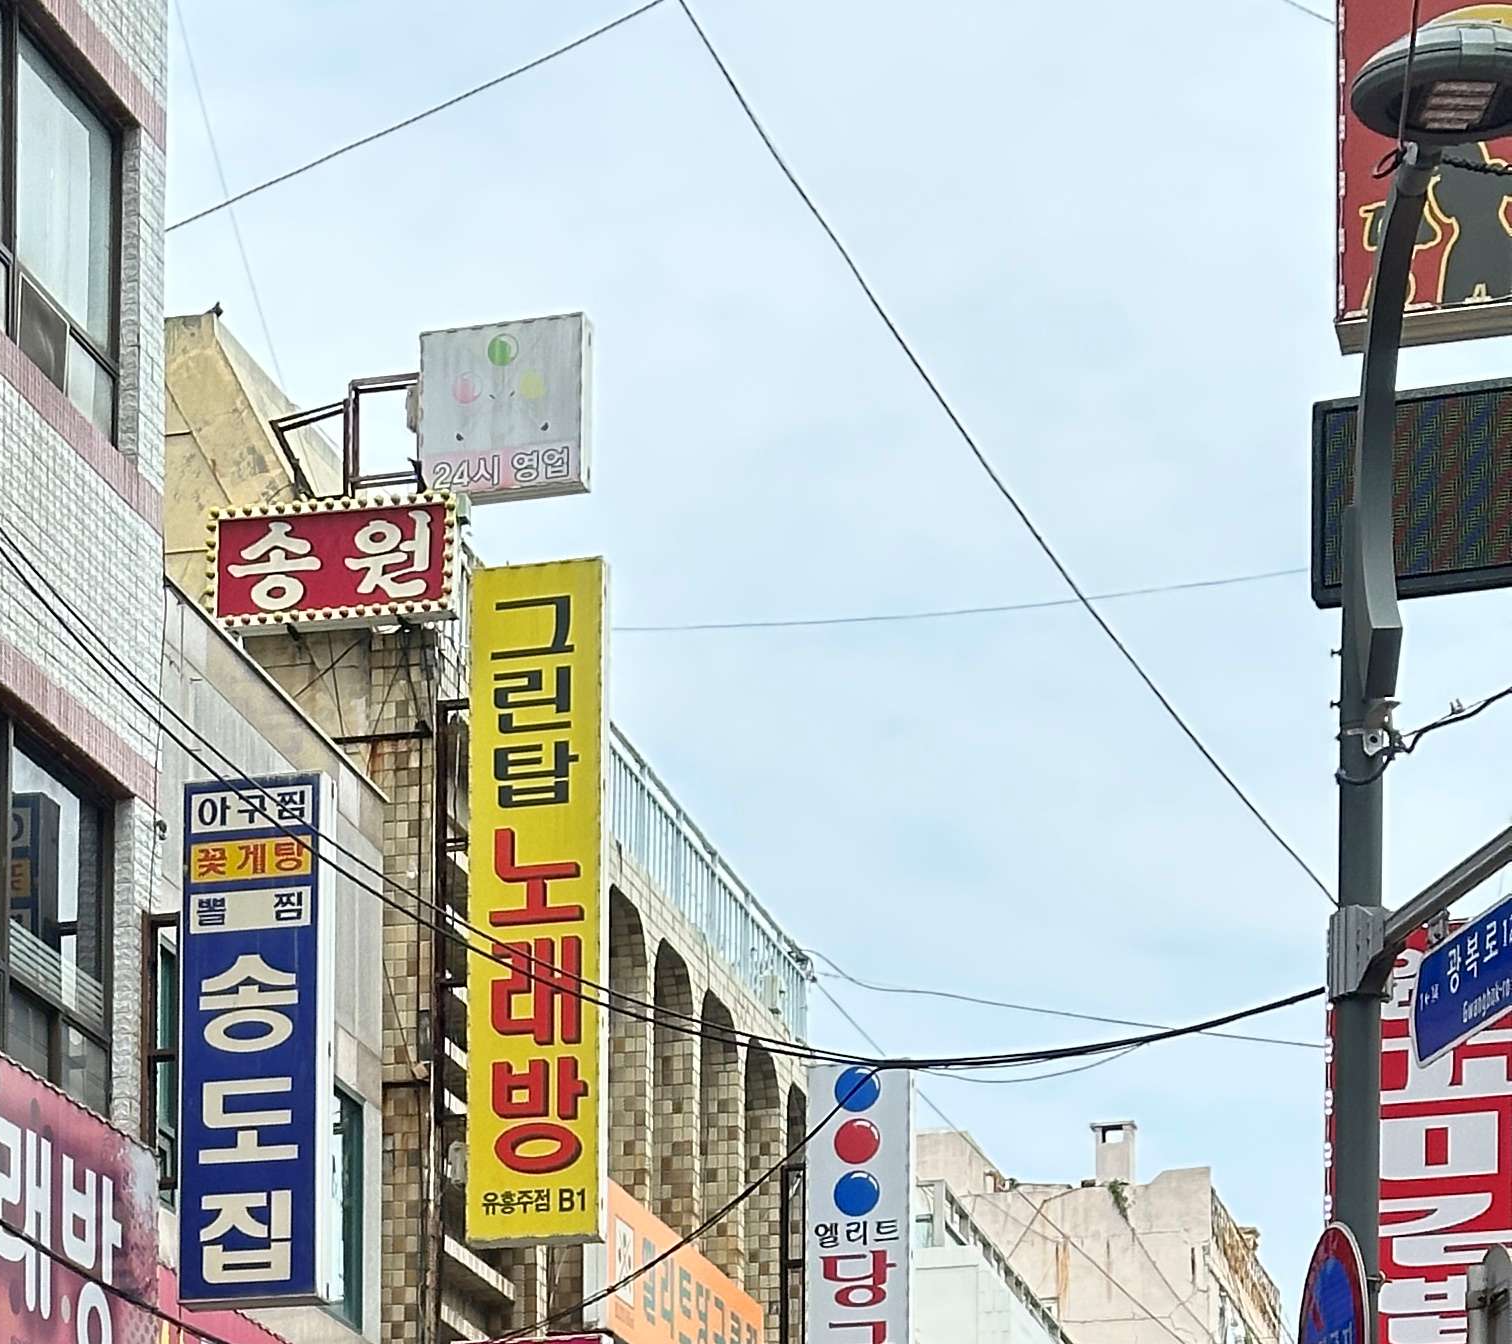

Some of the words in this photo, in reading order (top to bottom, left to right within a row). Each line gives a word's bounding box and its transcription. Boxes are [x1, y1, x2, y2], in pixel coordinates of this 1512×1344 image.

[432, 455, 502, 491] 24시
[511, 446, 570, 480] 영업
[227, 509, 433, 613] 송원
[490, 595, 579, 809] 그린탑
[198, 789, 306, 826] 아구찜
[197, 842, 305, 877] 꽃게탕
[488, 828, 587, 1174] 노래방
[198, 954, 299, 1284] 송도집
[558, 1188, 587, 1213] B1
[813, 1218, 899, 1249] 엘리트
